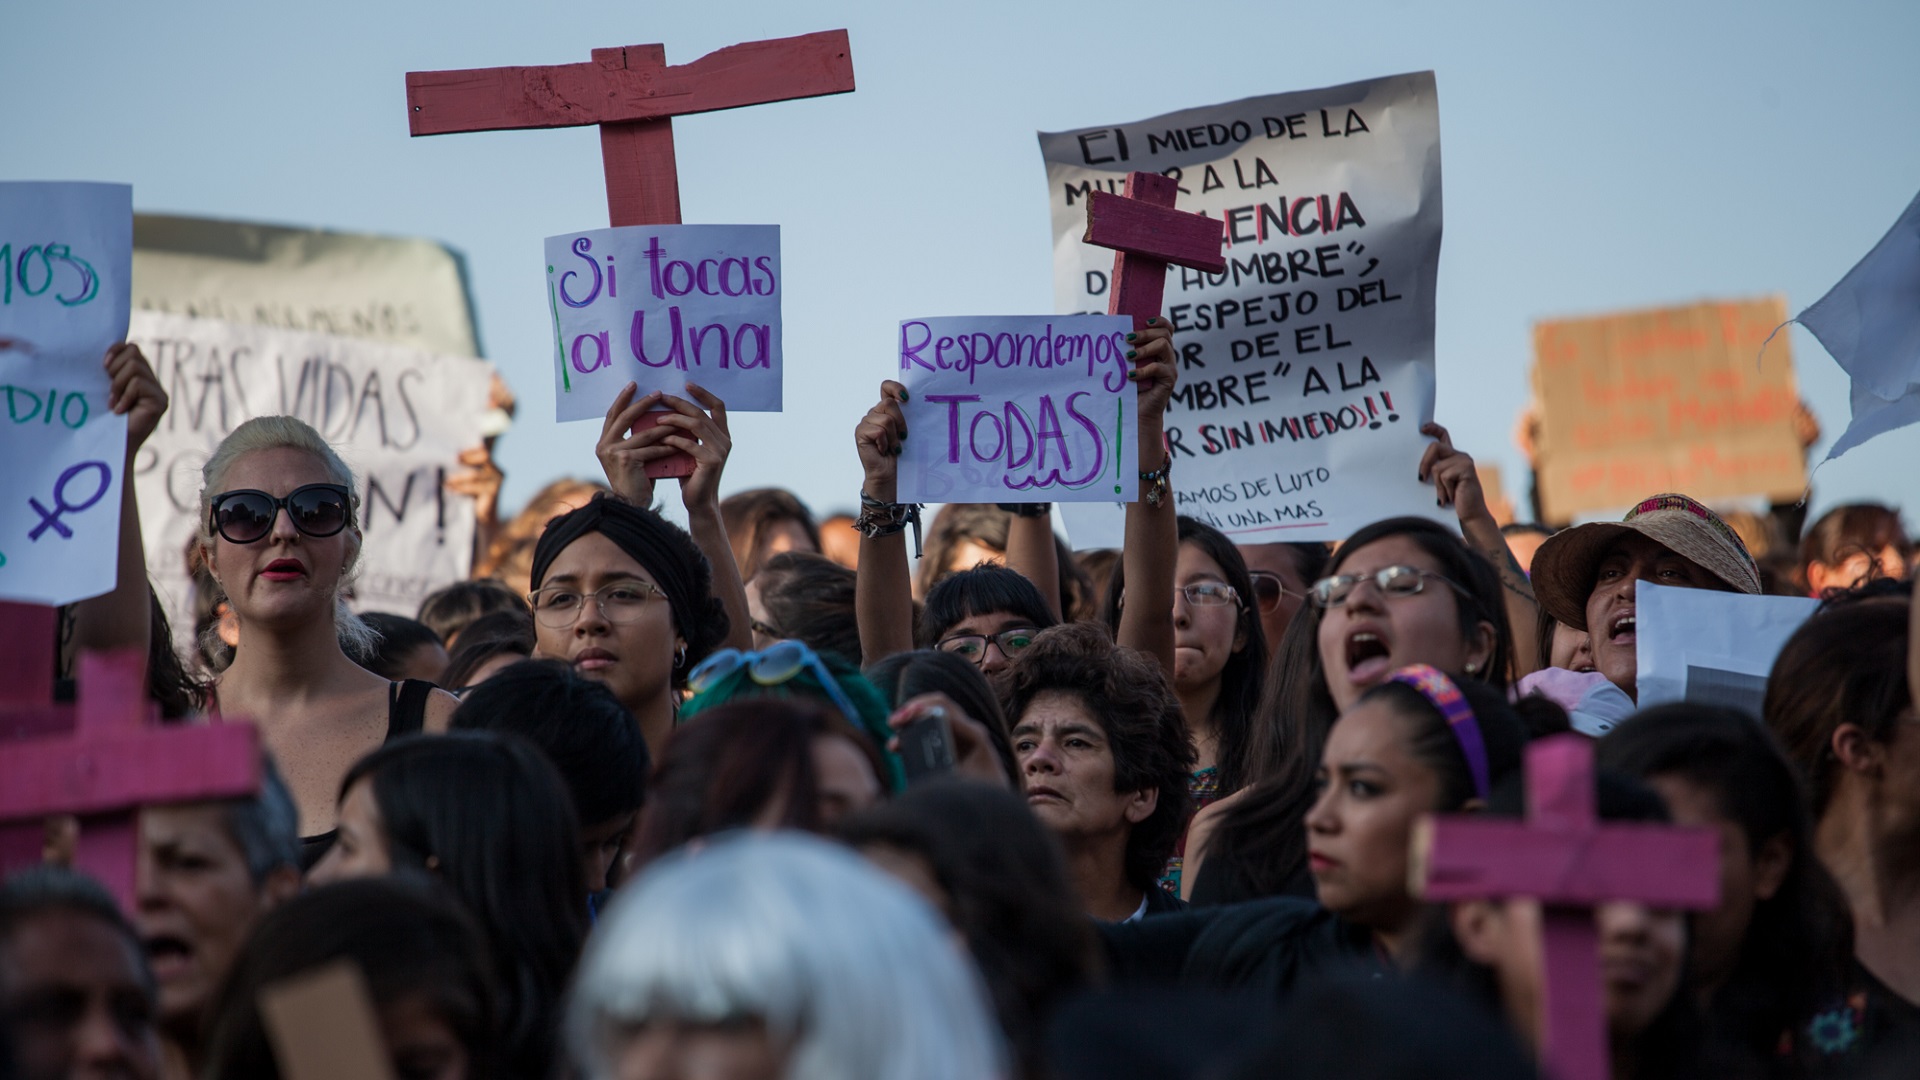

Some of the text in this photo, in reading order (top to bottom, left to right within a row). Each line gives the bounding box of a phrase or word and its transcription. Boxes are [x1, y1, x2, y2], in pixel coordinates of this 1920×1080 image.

[1147, 119, 1251, 155] MIEDO
[1262, 112, 1307, 139] DE
[1319, 108, 1370, 137] LA
[1201, 164, 1225, 194] A
[1233, 157, 1279, 190] LA
[643, 236, 776, 300] tocas
[1169, 279, 1402, 334] ESPEJO DEL
[630, 305, 770, 372] Una
[900, 320, 1128, 393] Respondemos
[1230, 331, 1280, 363] DE
[1294, 323, 1352, 354] EL
[1302, 365, 1331, 398] A
[1337, 355, 1381, 392] LA
[277, 353, 425, 450] VIDAS
[925, 391, 1123, 494] TODAS!
[1198, 420, 1256, 455] SIN
[1241, 477, 1271, 500] DE
[1275, 467, 1331, 495] LUTO
[1227, 507, 1272, 528] UNA
[1275, 500, 1324, 522] MAS
